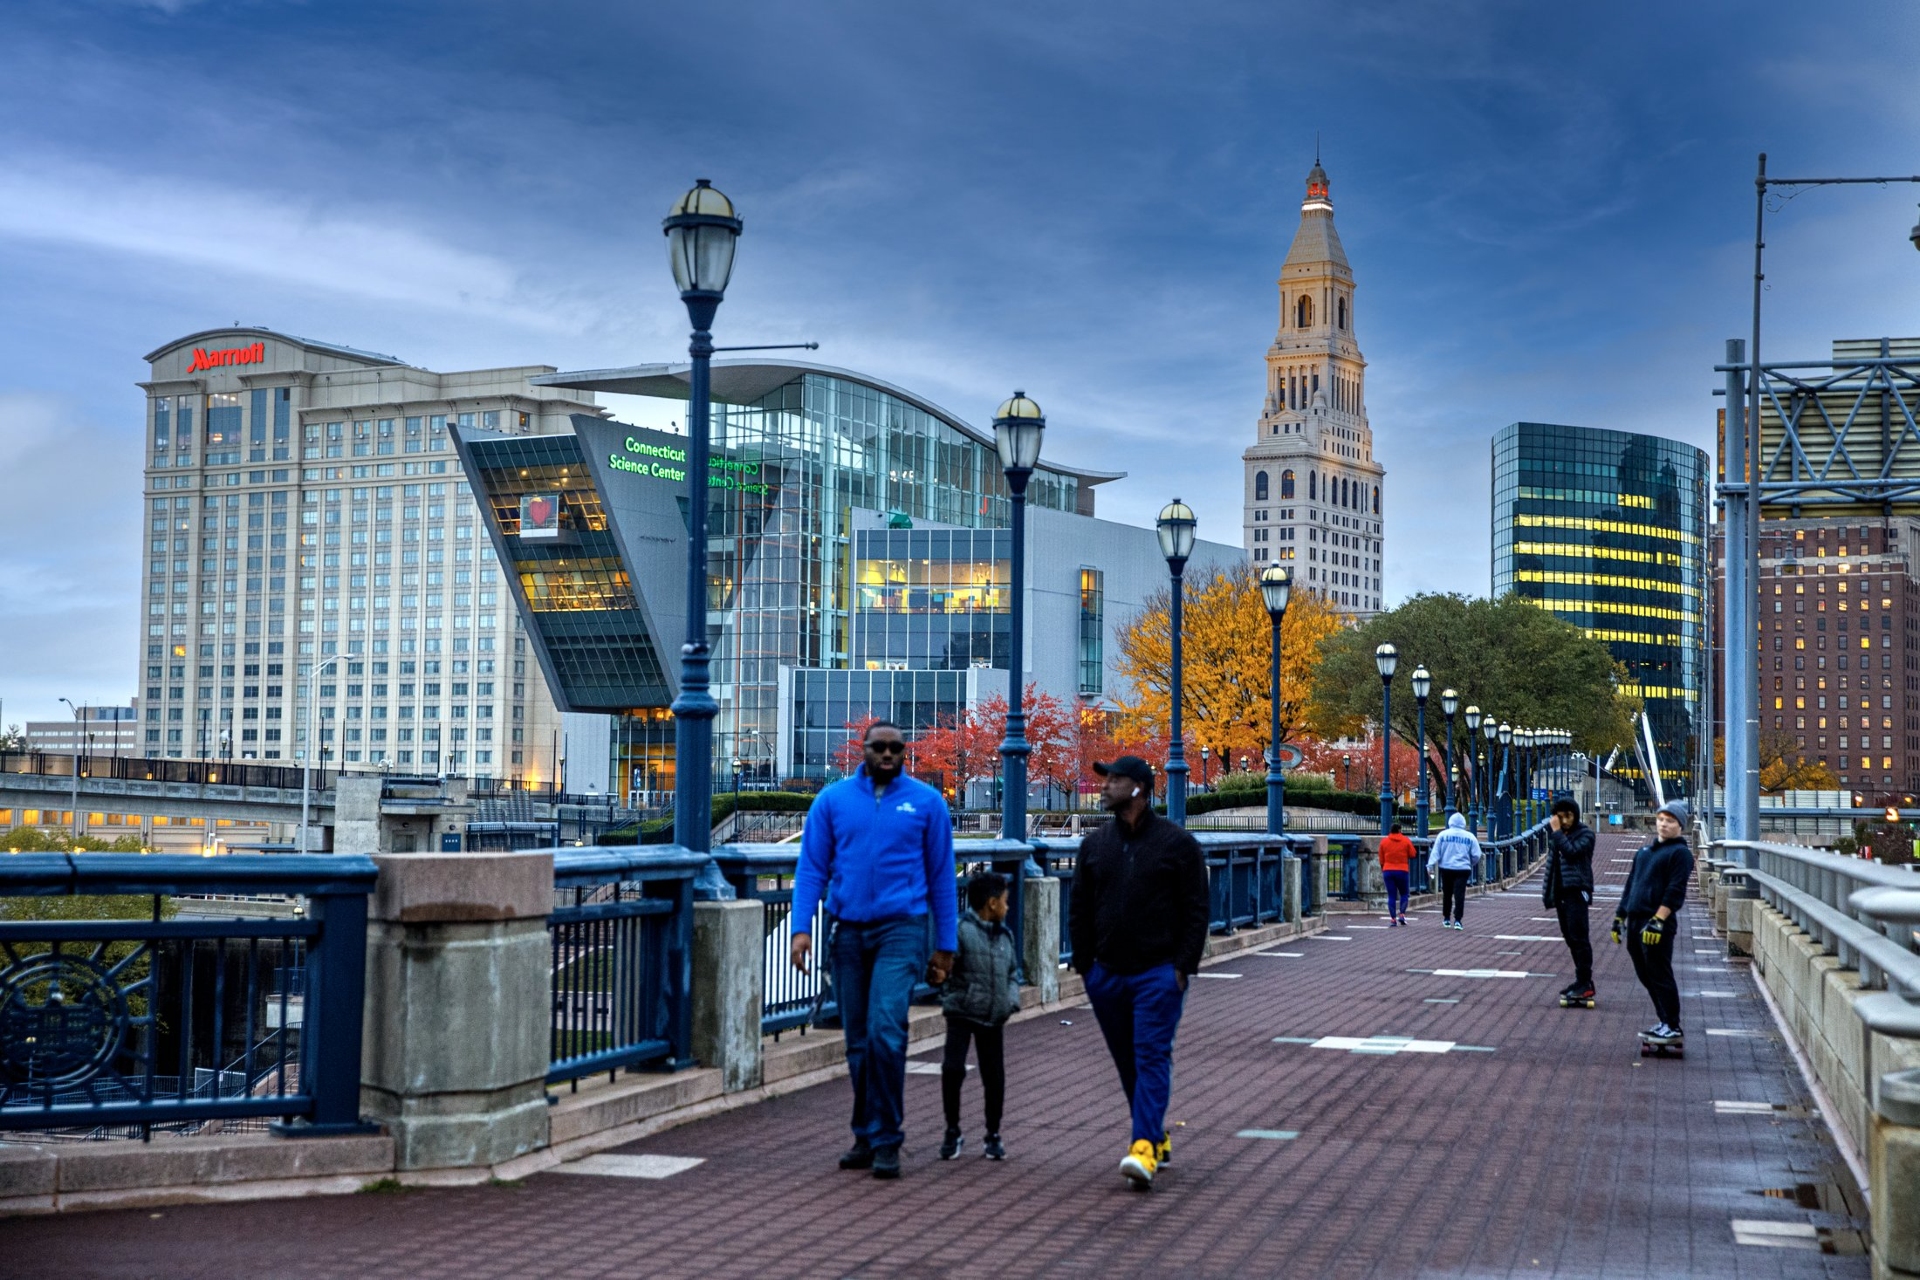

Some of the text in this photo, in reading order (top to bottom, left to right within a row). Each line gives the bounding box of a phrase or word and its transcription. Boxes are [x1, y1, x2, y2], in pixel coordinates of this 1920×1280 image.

[186, 342, 265, 373] Marriott
[625, 436, 686, 462] Connecticut
[609, 454, 686, 482] Science Center
